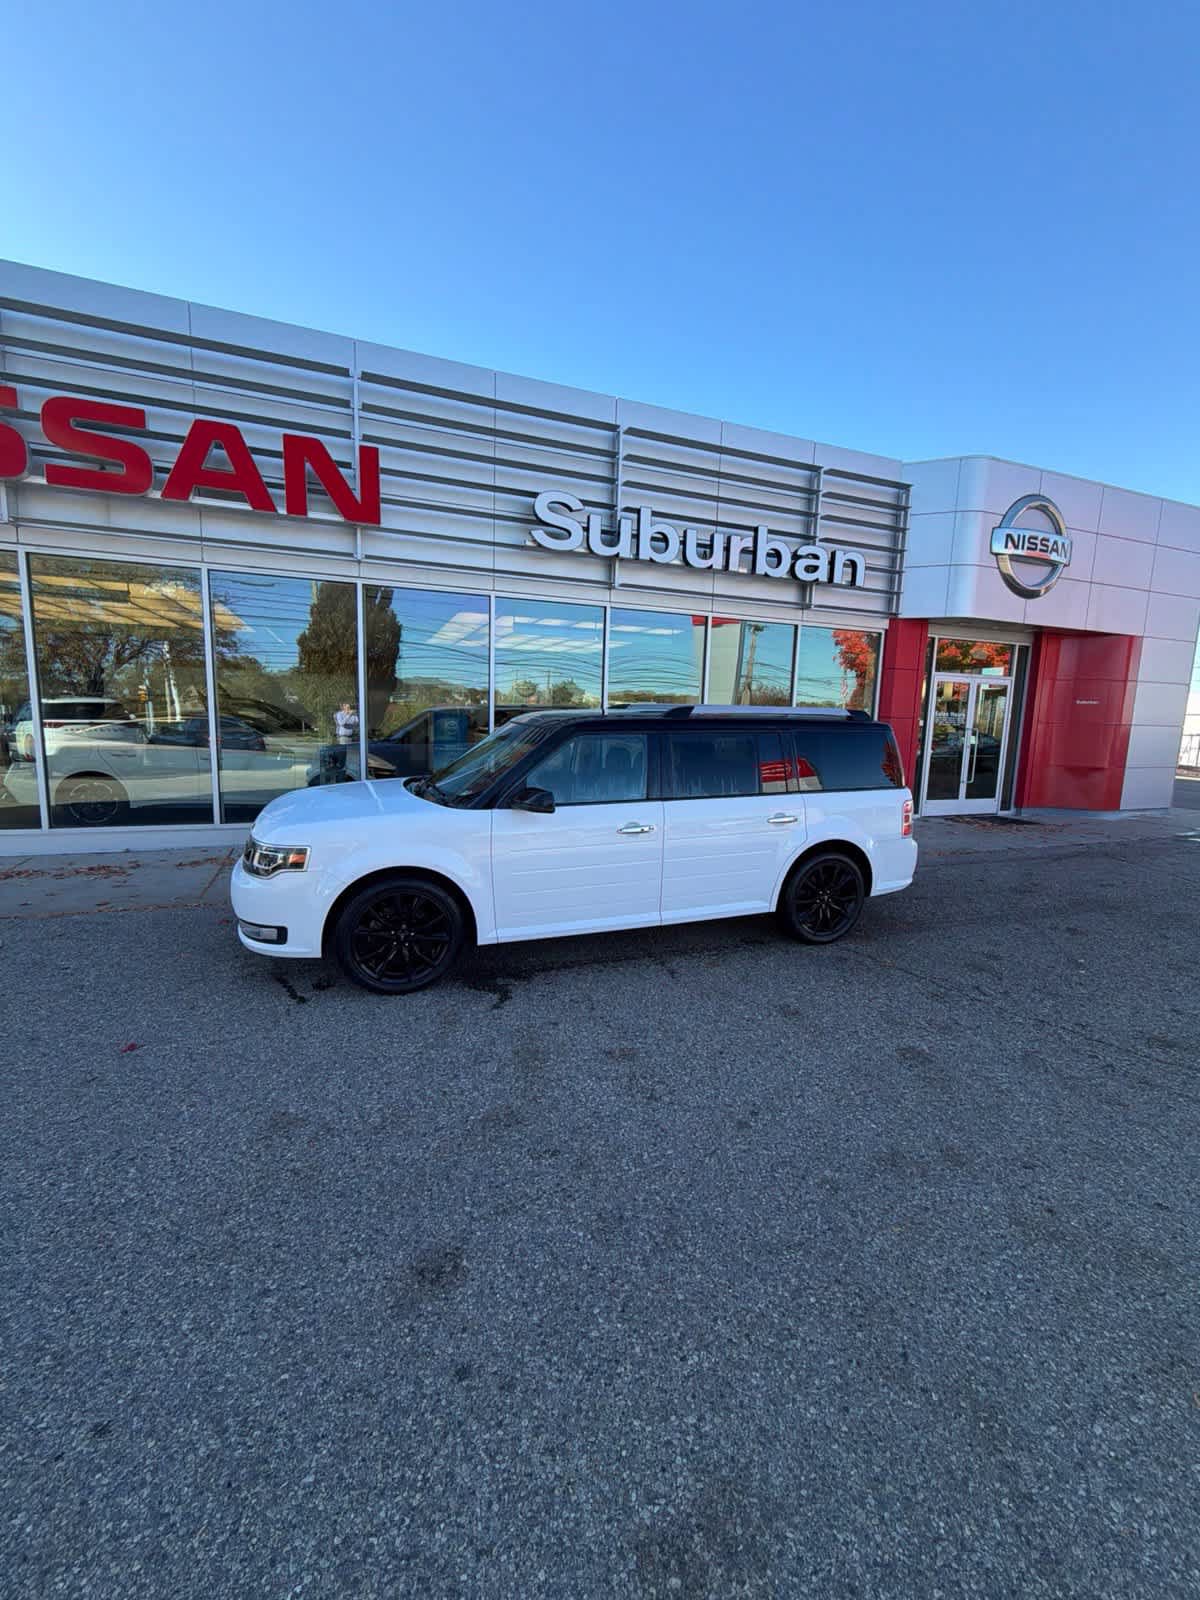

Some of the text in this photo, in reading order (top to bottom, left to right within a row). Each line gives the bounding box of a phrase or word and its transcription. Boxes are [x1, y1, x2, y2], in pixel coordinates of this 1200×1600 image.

[0, 385, 381, 525] SAN
[530, 490, 866, 587] Suburban
[1004, 533, 1068, 559] NISSAN
